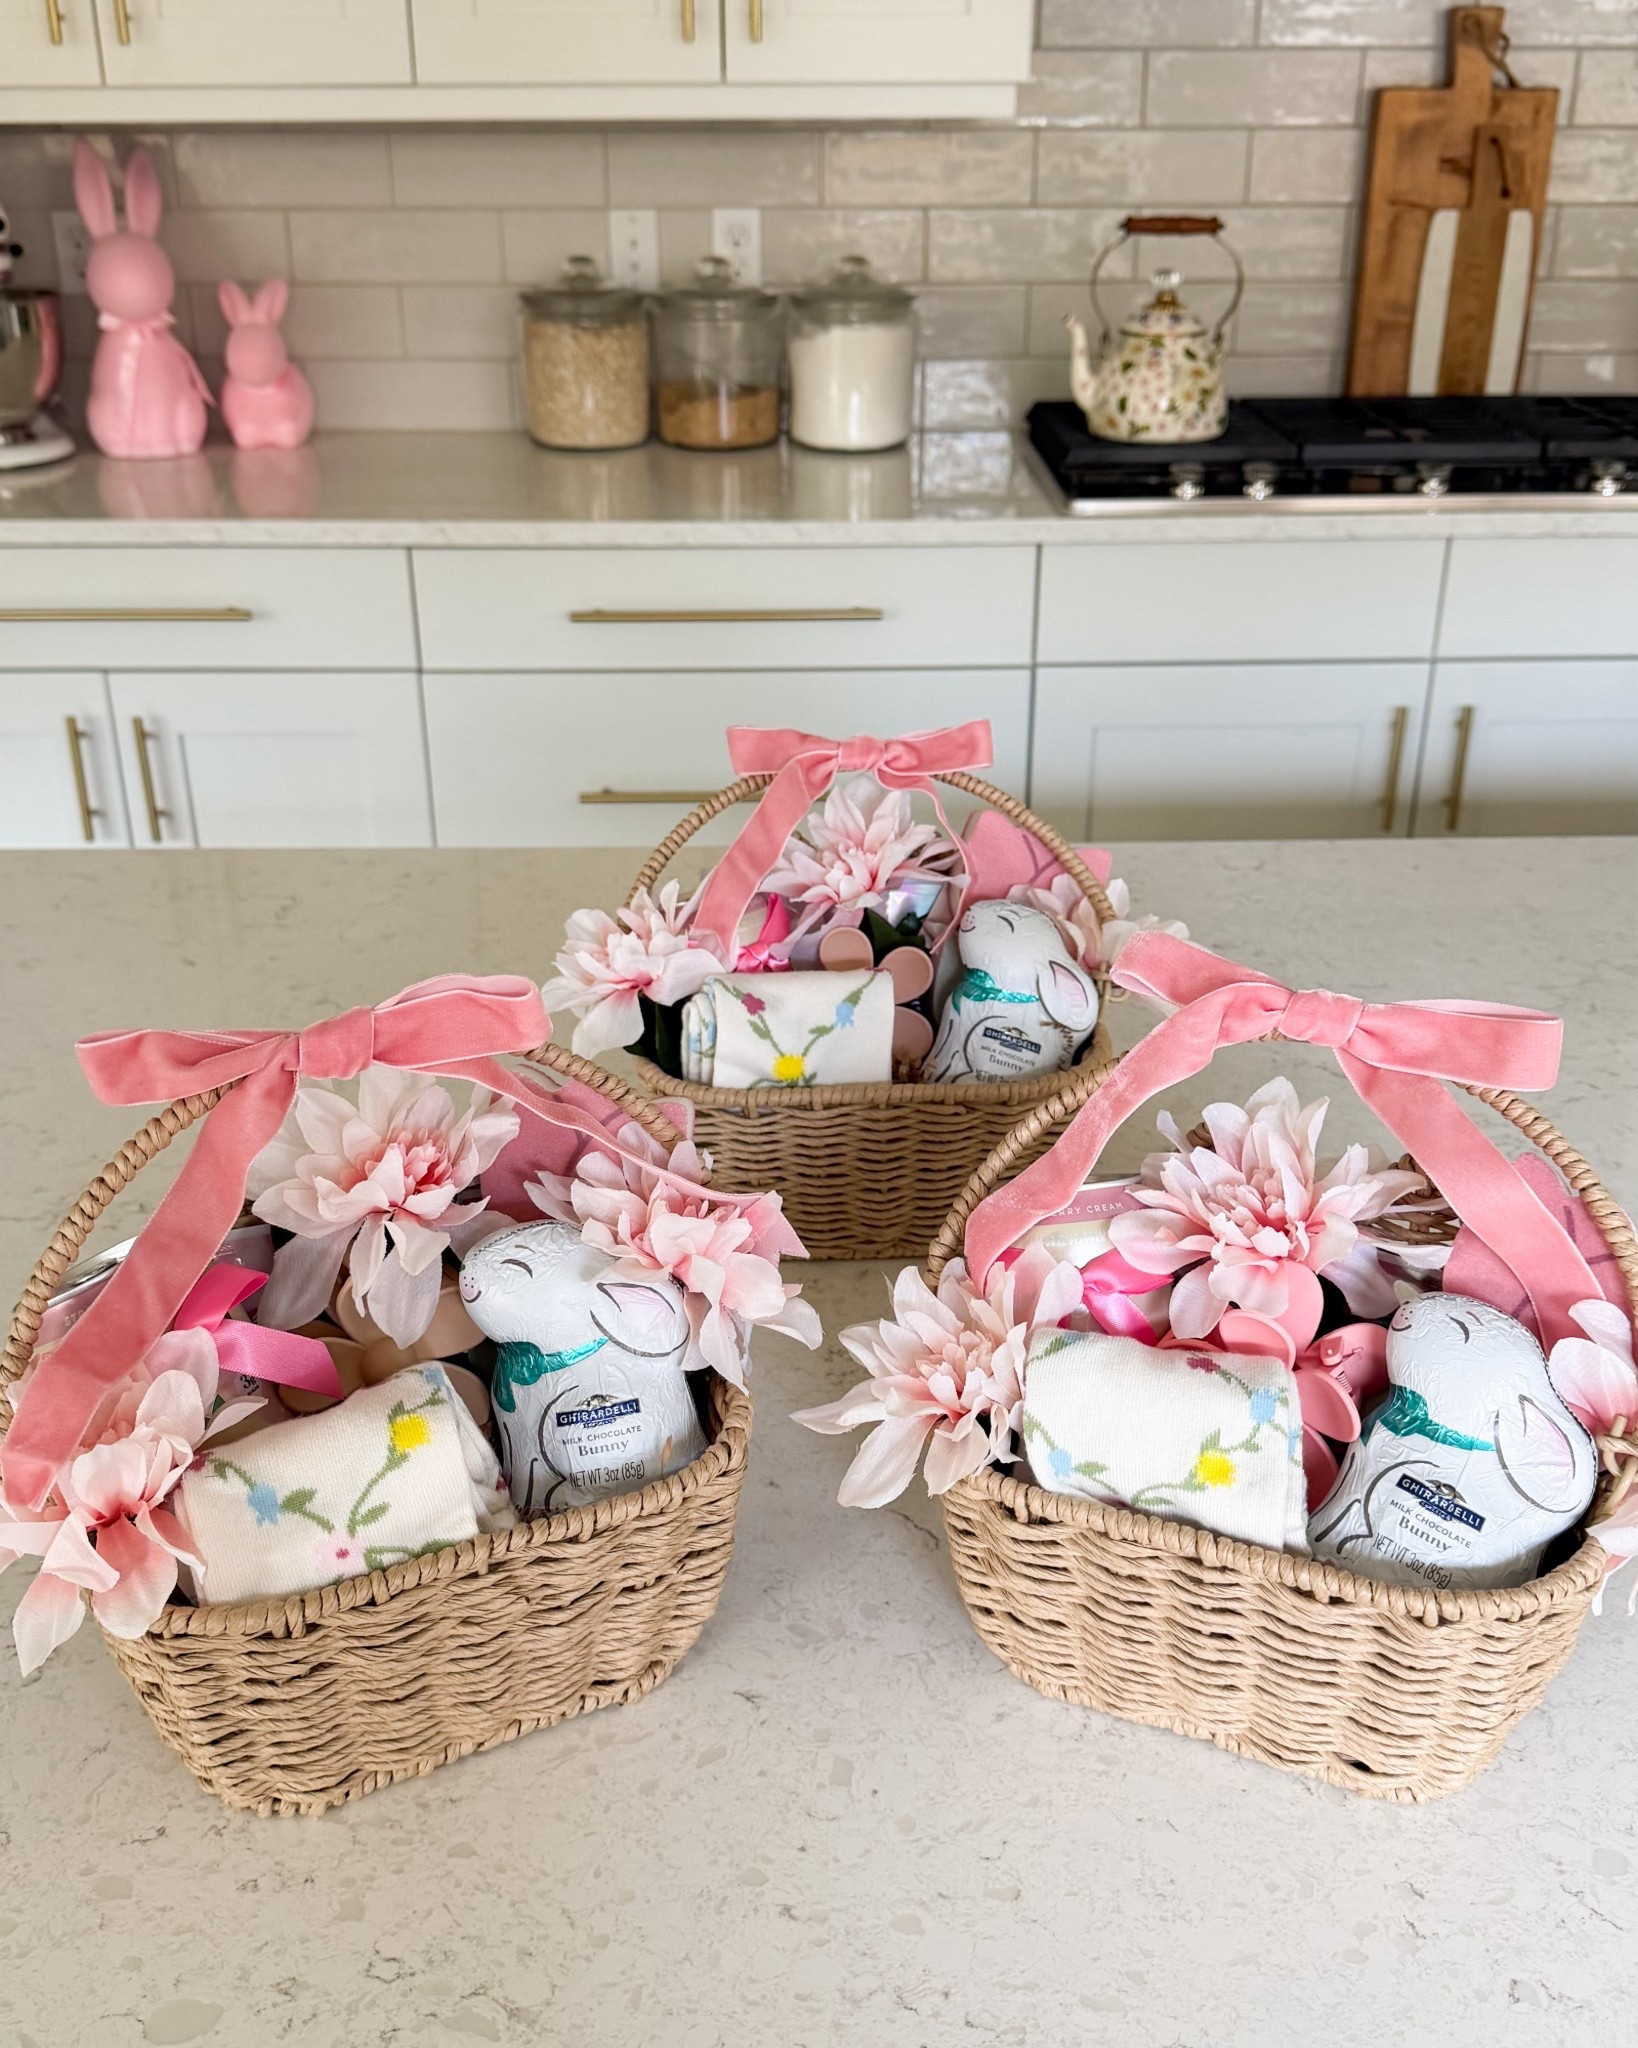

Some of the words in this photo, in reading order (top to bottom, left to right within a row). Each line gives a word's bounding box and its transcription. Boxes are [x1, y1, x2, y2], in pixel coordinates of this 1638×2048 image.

[1086, 1201, 1124, 1214] CREAM
[559, 1401, 638, 1424] GHIRARDELLI
[562, 1436, 584, 1446] MILK
[587, 1424, 642, 1442] CHOCOLATE
[578, 1440, 630, 1457] Bunny
[569, 1470, 586, 1488] NET
[587, 1467, 602, 1486] WT
[603, 1466, 620, 1483] 3oz
[621, 1460, 645, 1481] (85g)
[1400, 1477, 1481, 1527] GHIRARDELLI
[1389, 1499, 1413, 1516] MILK
[1415, 1512, 1473, 1549] CHOCOLATE
[1398, 1515, 1453, 1553] Bunny
[1372, 1531, 1395, 1554] NET
[1390, 1541, 1411, 1564] WT
[1405, 1552, 1427, 1575] 3oz
[1422, 1561, 1453, 1590] (85g)
